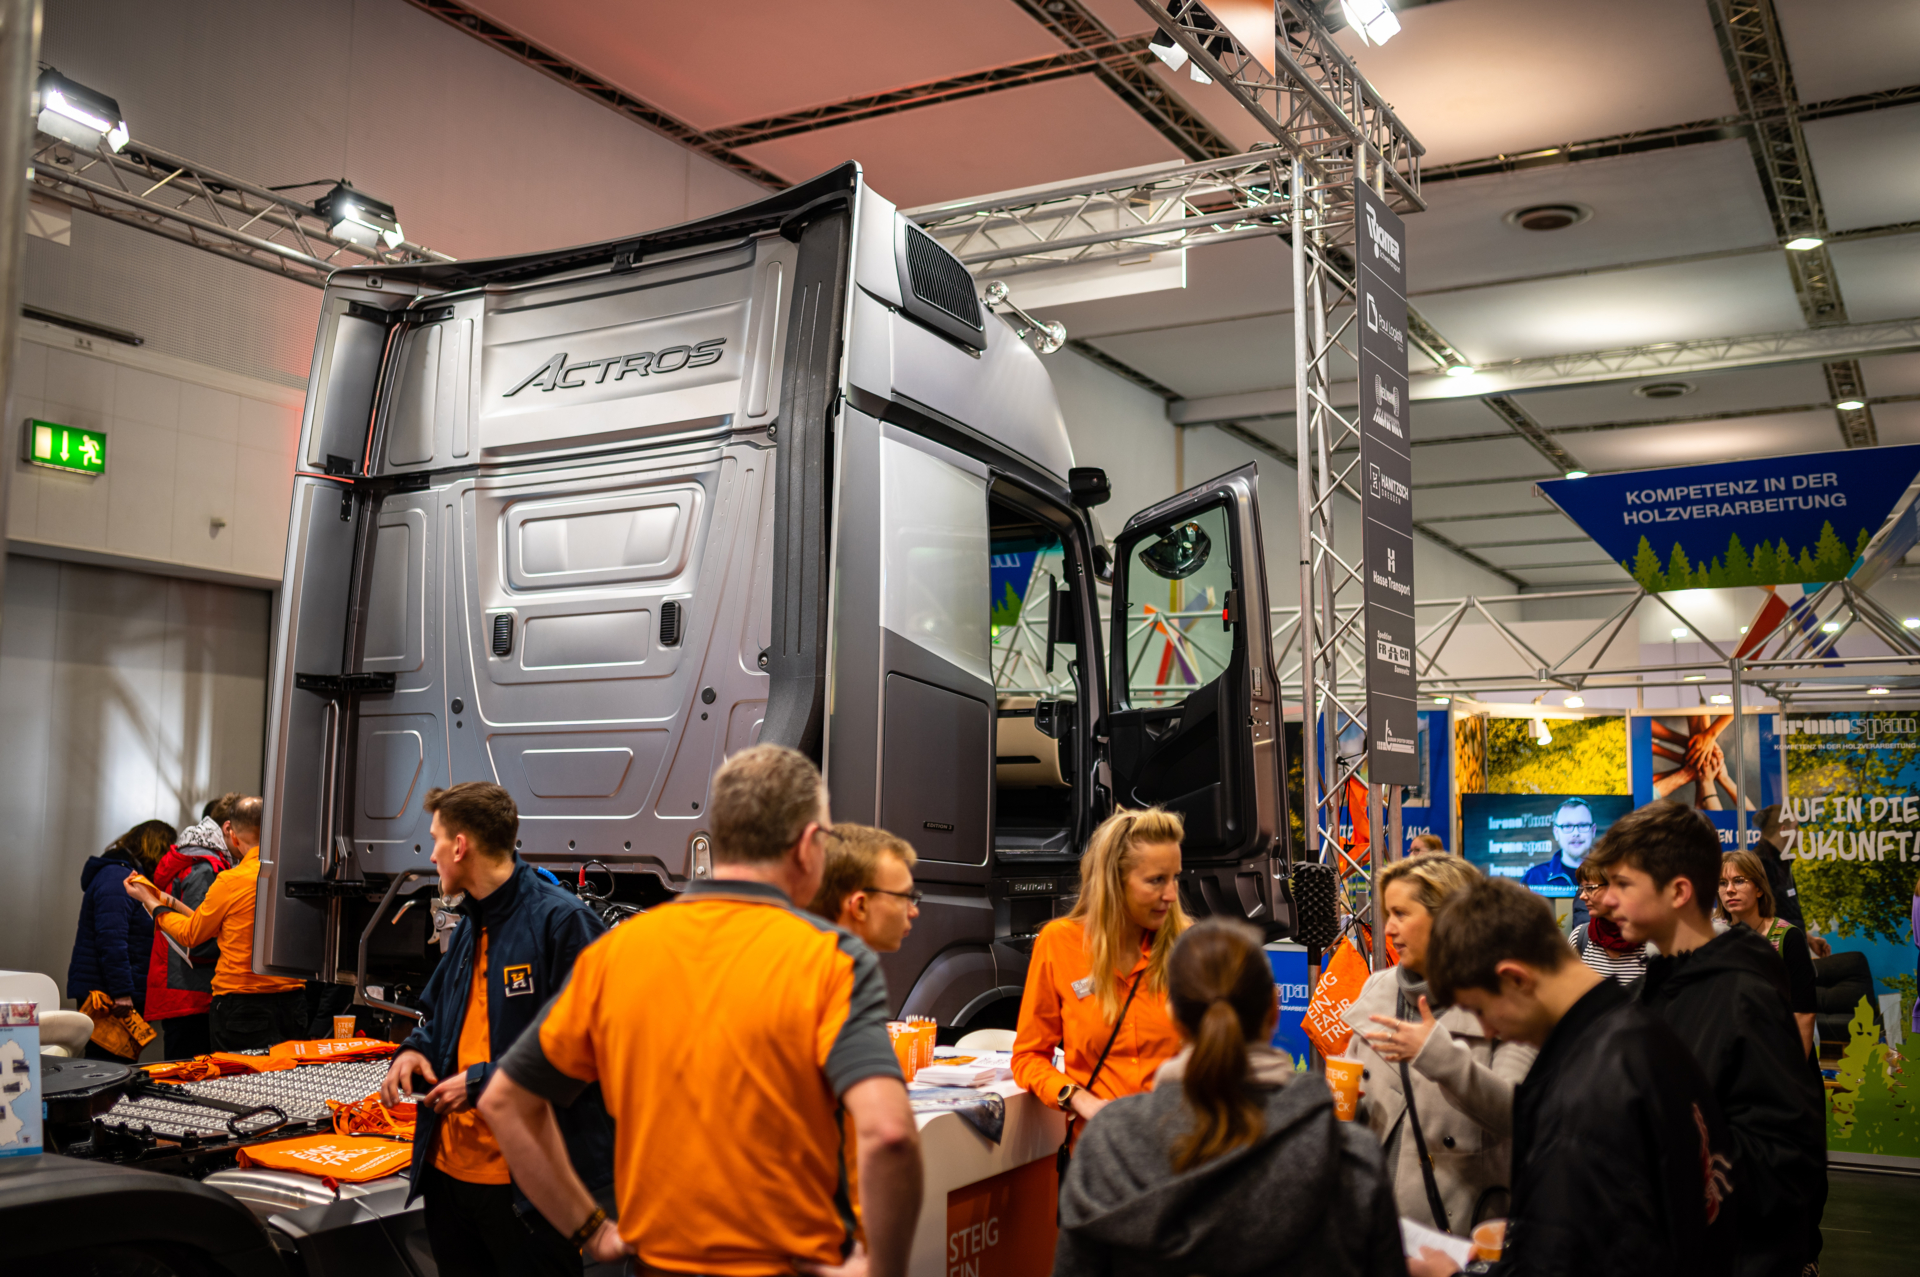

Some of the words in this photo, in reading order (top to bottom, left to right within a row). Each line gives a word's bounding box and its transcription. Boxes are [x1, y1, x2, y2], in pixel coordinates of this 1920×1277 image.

[502, 337, 727, 397] ACTROS
[1381, 488, 1401, 505] DRESDEN
[1625, 479, 1758, 506] KOMPETENZ
[1763, 476, 1785, 492] IN
[1792, 472, 1838, 490] DER
[1623, 492, 1847, 526] HOLZVERARBEITUNG
[1373, 570, 1388, 588] Hasse
[1388, 576, 1411, 596] Transport
[1772, 715, 1917, 741] kronospan
[1842, 742, 1917, 750] HOLZVERARBEITUNG
[1778, 796, 1827, 824] AUF
[1832, 796, 1862, 823] IN
[1869, 795, 1920, 824] DIE
[1779, 829, 1920, 862] ZUKUNFT!
[949, 1216, 999, 1264] STEIG
